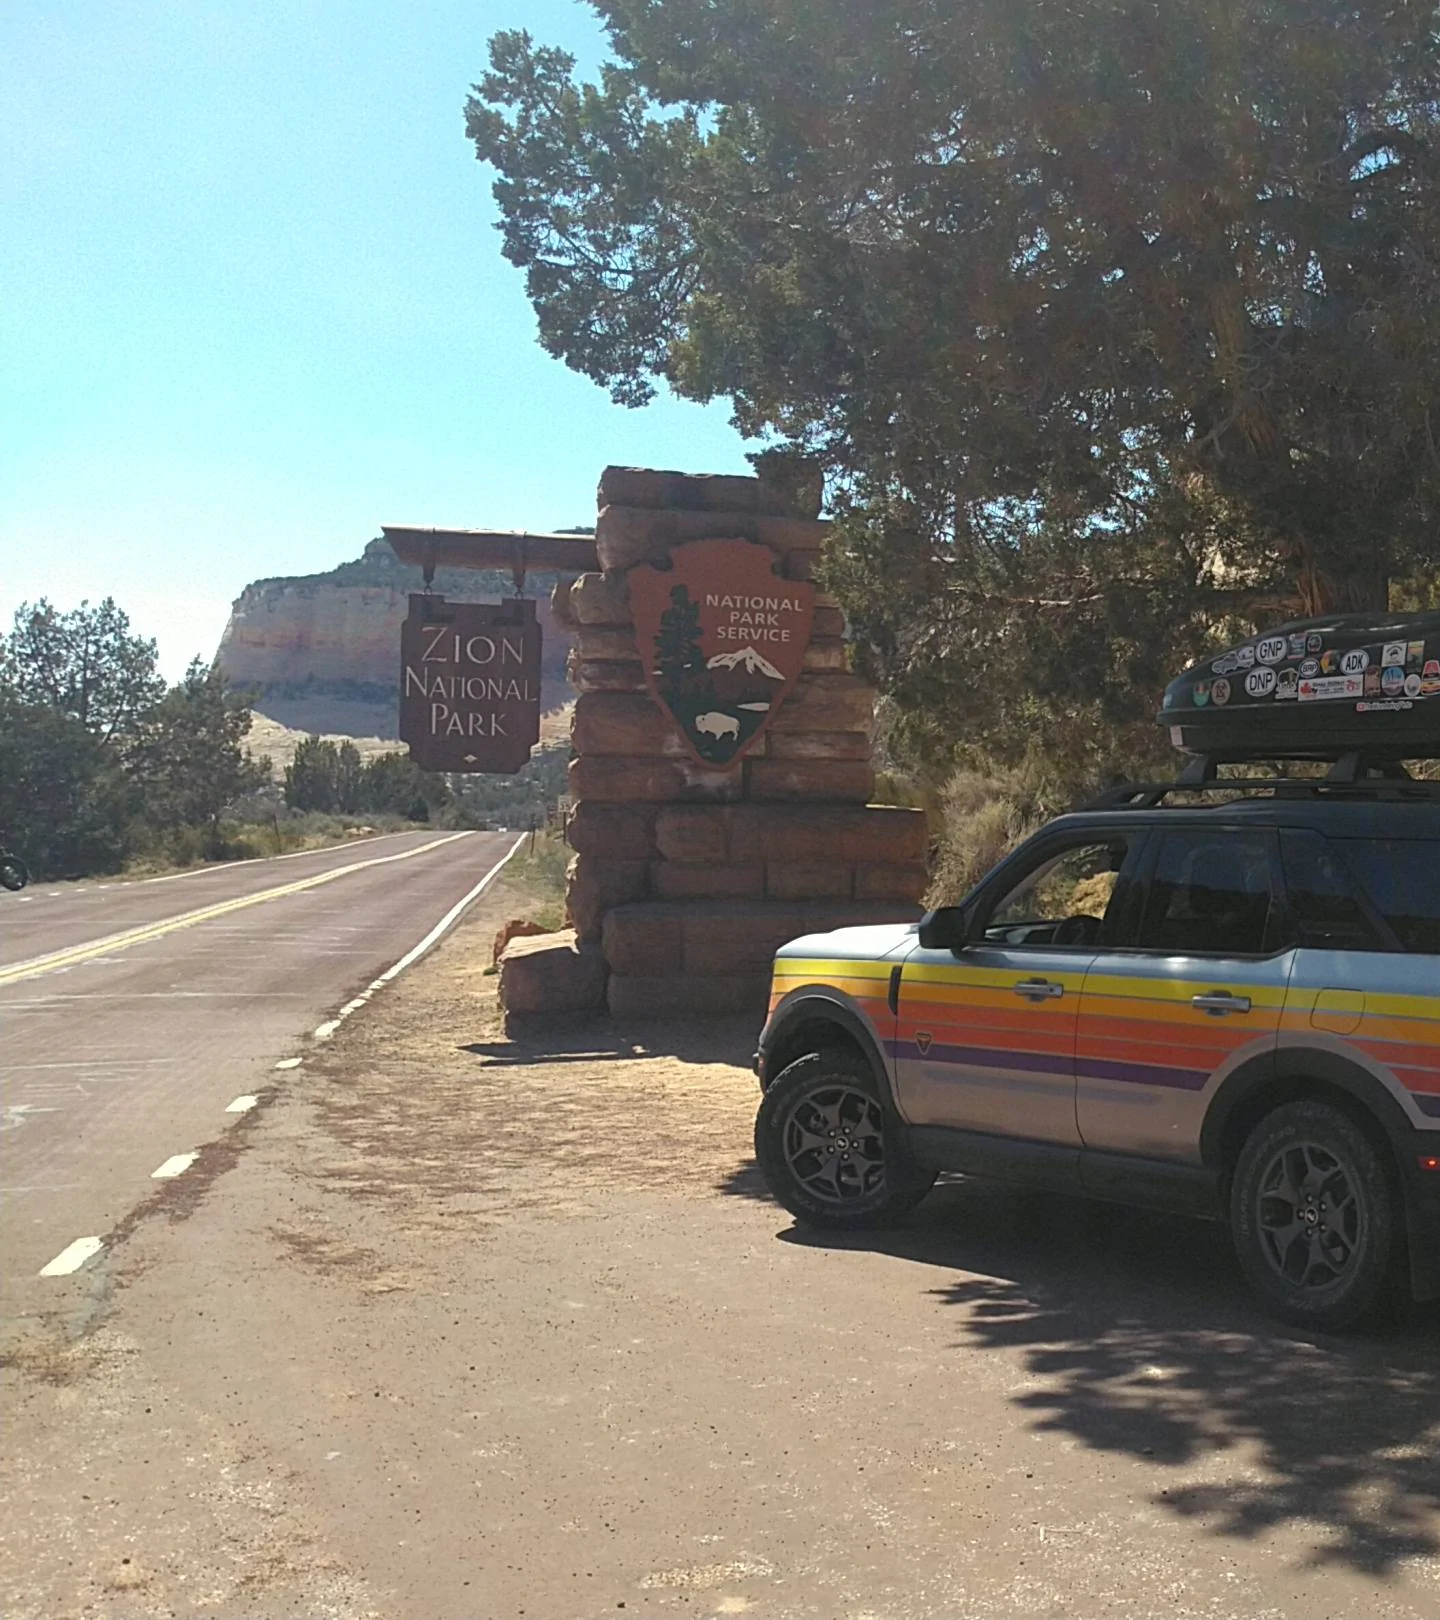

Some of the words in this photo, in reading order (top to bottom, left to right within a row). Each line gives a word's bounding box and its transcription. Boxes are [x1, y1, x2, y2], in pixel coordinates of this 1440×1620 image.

[706, 593, 803, 613] NATIONAL
[729, 611, 779, 627] PARK
[716, 626, 791, 643] SERVICE
[421, 627, 524, 665] ZION
[1260, 640, 1283, 658] GNP
[1345, 656, 1363, 671] ADK
[405, 665, 537, 701] NATIONAL
[1249, 673, 1273, 691] DNP
[430, 703, 508, 737] PARK
